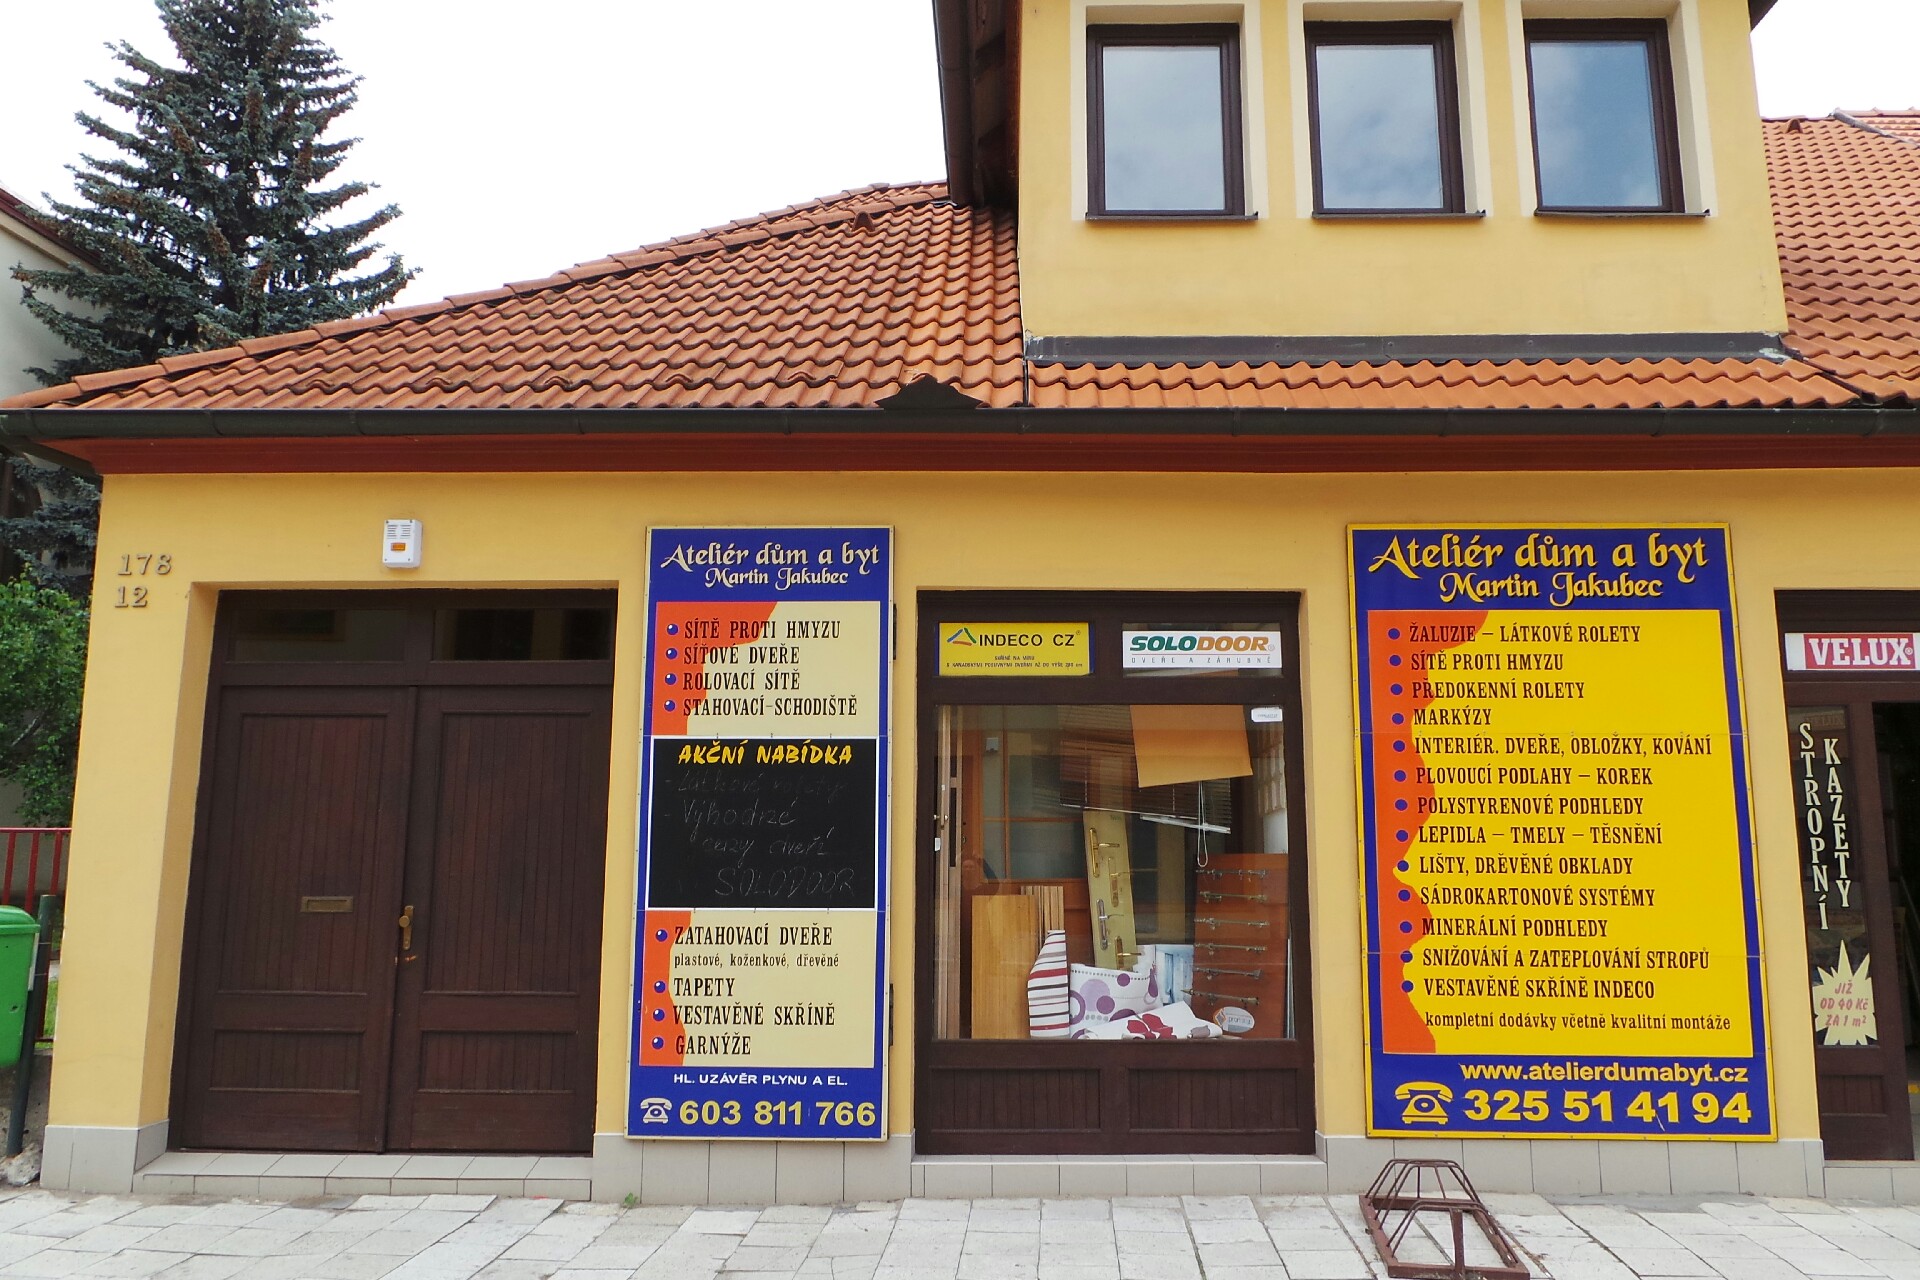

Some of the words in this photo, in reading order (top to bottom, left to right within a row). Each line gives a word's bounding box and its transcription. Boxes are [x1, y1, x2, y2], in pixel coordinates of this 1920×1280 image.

[117, 553, 172, 576] 178
[661, 542, 749, 572] Ateliér
[756, 542, 808, 565] dům
[818, 549, 833, 565] a
[841, 542, 880, 575] byt
[1368, 533, 1504, 579] Ateliér
[1514, 533, 1597, 568] dům
[1612, 544, 1637, 567] a
[1648, 532, 1709, 583] byt
[705, 567, 769, 588] Martin
[775, 567, 849, 591] Jakubec
[1439, 572, 1540, 603] Martin
[1550, 571, 1664, 607] Jakubec
[114, 586, 149, 608] 12
[684, 617, 720, 639] SÍTĚ
[730, 620, 776, 639] PROTI
[786, 620, 841, 639] HMYZU
[1409, 621, 1476, 643] ŽALUZIE
[1500, 621, 1573, 643] LÁTKOVÉ
[1578, 626, 1641, 643] ROLETY
[980, 634, 1043, 647] INDECO
[1808, 638, 1911, 665] VELUX
[684, 643, 739, 665] SÍŤOVÉ
[749, 643, 800, 664] DVEŘE
[1131, 656, 1176, 664] DVEŘE
[1411, 650, 1447, 671] SÍTĚ
[1453, 654, 1500, 671] PROTI
[1507, 654, 1564, 671] HMYZU
[682, 668, 755, 690] ROLOVACÍ
[765, 668, 800, 690] SÍTĚ
[1412, 677, 1518, 699] PŘEDOKENNÍ
[1523, 682, 1585, 699] ROLETY
[1413, 704, 1491, 726] MARKÝZY
[678, 739, 749, 765] AKČNÍ
[756, 739, 852, 765] NABÍDKA
[1415, 733, 1499, 754] INTERIÉR.
[1505, 733, 1565, 758] DVEŘE,
[1571, 733, 1647, 758] OBLOŽKY,
[1653, 733, 1712, 755] KOVÁNÍ
[1416, 763, 1492, 784] PLOVOUCÍ
[1498, 767, 1572, 784] PODLAHY
[1596, 767, 1653, 785] KOREK
[1418, 793, 1554, 815] POLYSTYRENOVÉ
[1559, 797, 1643, 815] PODHLEDY
[1418, 826, 1486, 844] LEPIDLA
[1510, 827, 1565, 844] TMELY
[1590, 822, 1663, 844] TĚSNĚNÍ
[1799, 722, 1829, 930] STROPNÍ
[1823, 738, 1851, 907] KAZETY
[1419, 853, 1469, 876] LIŠTY,
[1559, 857, 1633, 875] OBKLADY
[1420, 883, 1574, 906] SÁDROKARTONOVÉ
[1579, 884, 1655, 907] SYSTÉMY
[674, 923, 769, 946] ZATAHOVACÍ
[780, 923, 832, 946] DVEŘE
[1422, 914, 1517, 936] MINERÁLNÍ
[1523, 919, 1608, 937] PODHLEDY
[674, 953, 723, 969] plastové,
[730, 952, 789, 969] koženkové,
[796, 953, 839, 967] dřevěné
[1423, 944, 1509, 968] SNIŽOVÁNÍ
[1514, 950, 1525, 968] A
[1530, 946, 1640, 969] ZATEPLOVÁNÍ
[1646, 947, 1710, 969] STROPŮ
[674, 978, 735, 997] TAPETY
[1424, 974, 1520, 998] VESTAVĚNÉ
[1525, 974, 1588, 998] SKŘÍNĚ
[1593, 981, 1655, 998] INDECO
[1835, 980, 1853, 994] JIŽ
[673, 1002, 764, 1026] VESTAVĚNÉ
[774, 1002, 835, 1026] SKŘÍNĚ
[1820, 998, 1835, 1010] OD
[1856, 998, 1869, 1010] Kč
[1425, 1012, 1494, 1029] kompletní
[1499, 1012, 1556, 1031] dodávky
[1562, 1013, 1606, 1029] včetně
[1611, 1012, 1666, 1029] kvalitní
[1671, 1014, 1731, 1030] montáže
[1825, 1014, 1840, 1026] ZA
[1843, 1015, 1849, 1027] 1
[676, 1032, 751, 1055] GARNÝŽE
[674, 1073, 695, 1084] HL.
[699, 1072, 757, 1085] UZÁVĚR
[763, 1075, 807, 1086] PLYNU
[812, 1076, 823, 1086] A
[828, 1076, 848, 1086] EL.
[1460, 1062, 1748, 1086] www.atelierdumabyt.cz
[679, 1100, 741, 1125] 603
[754, 1100, 802, 1125] 811
[815, 1101, 876, 1126] 766
[1464, 1089, 1550, 1121] 325
[1564, 1090, 1614, 1122] 51
[1627, 1091, 1680, 1123] 41
[1693, 1091, 1752, 1124] 94
